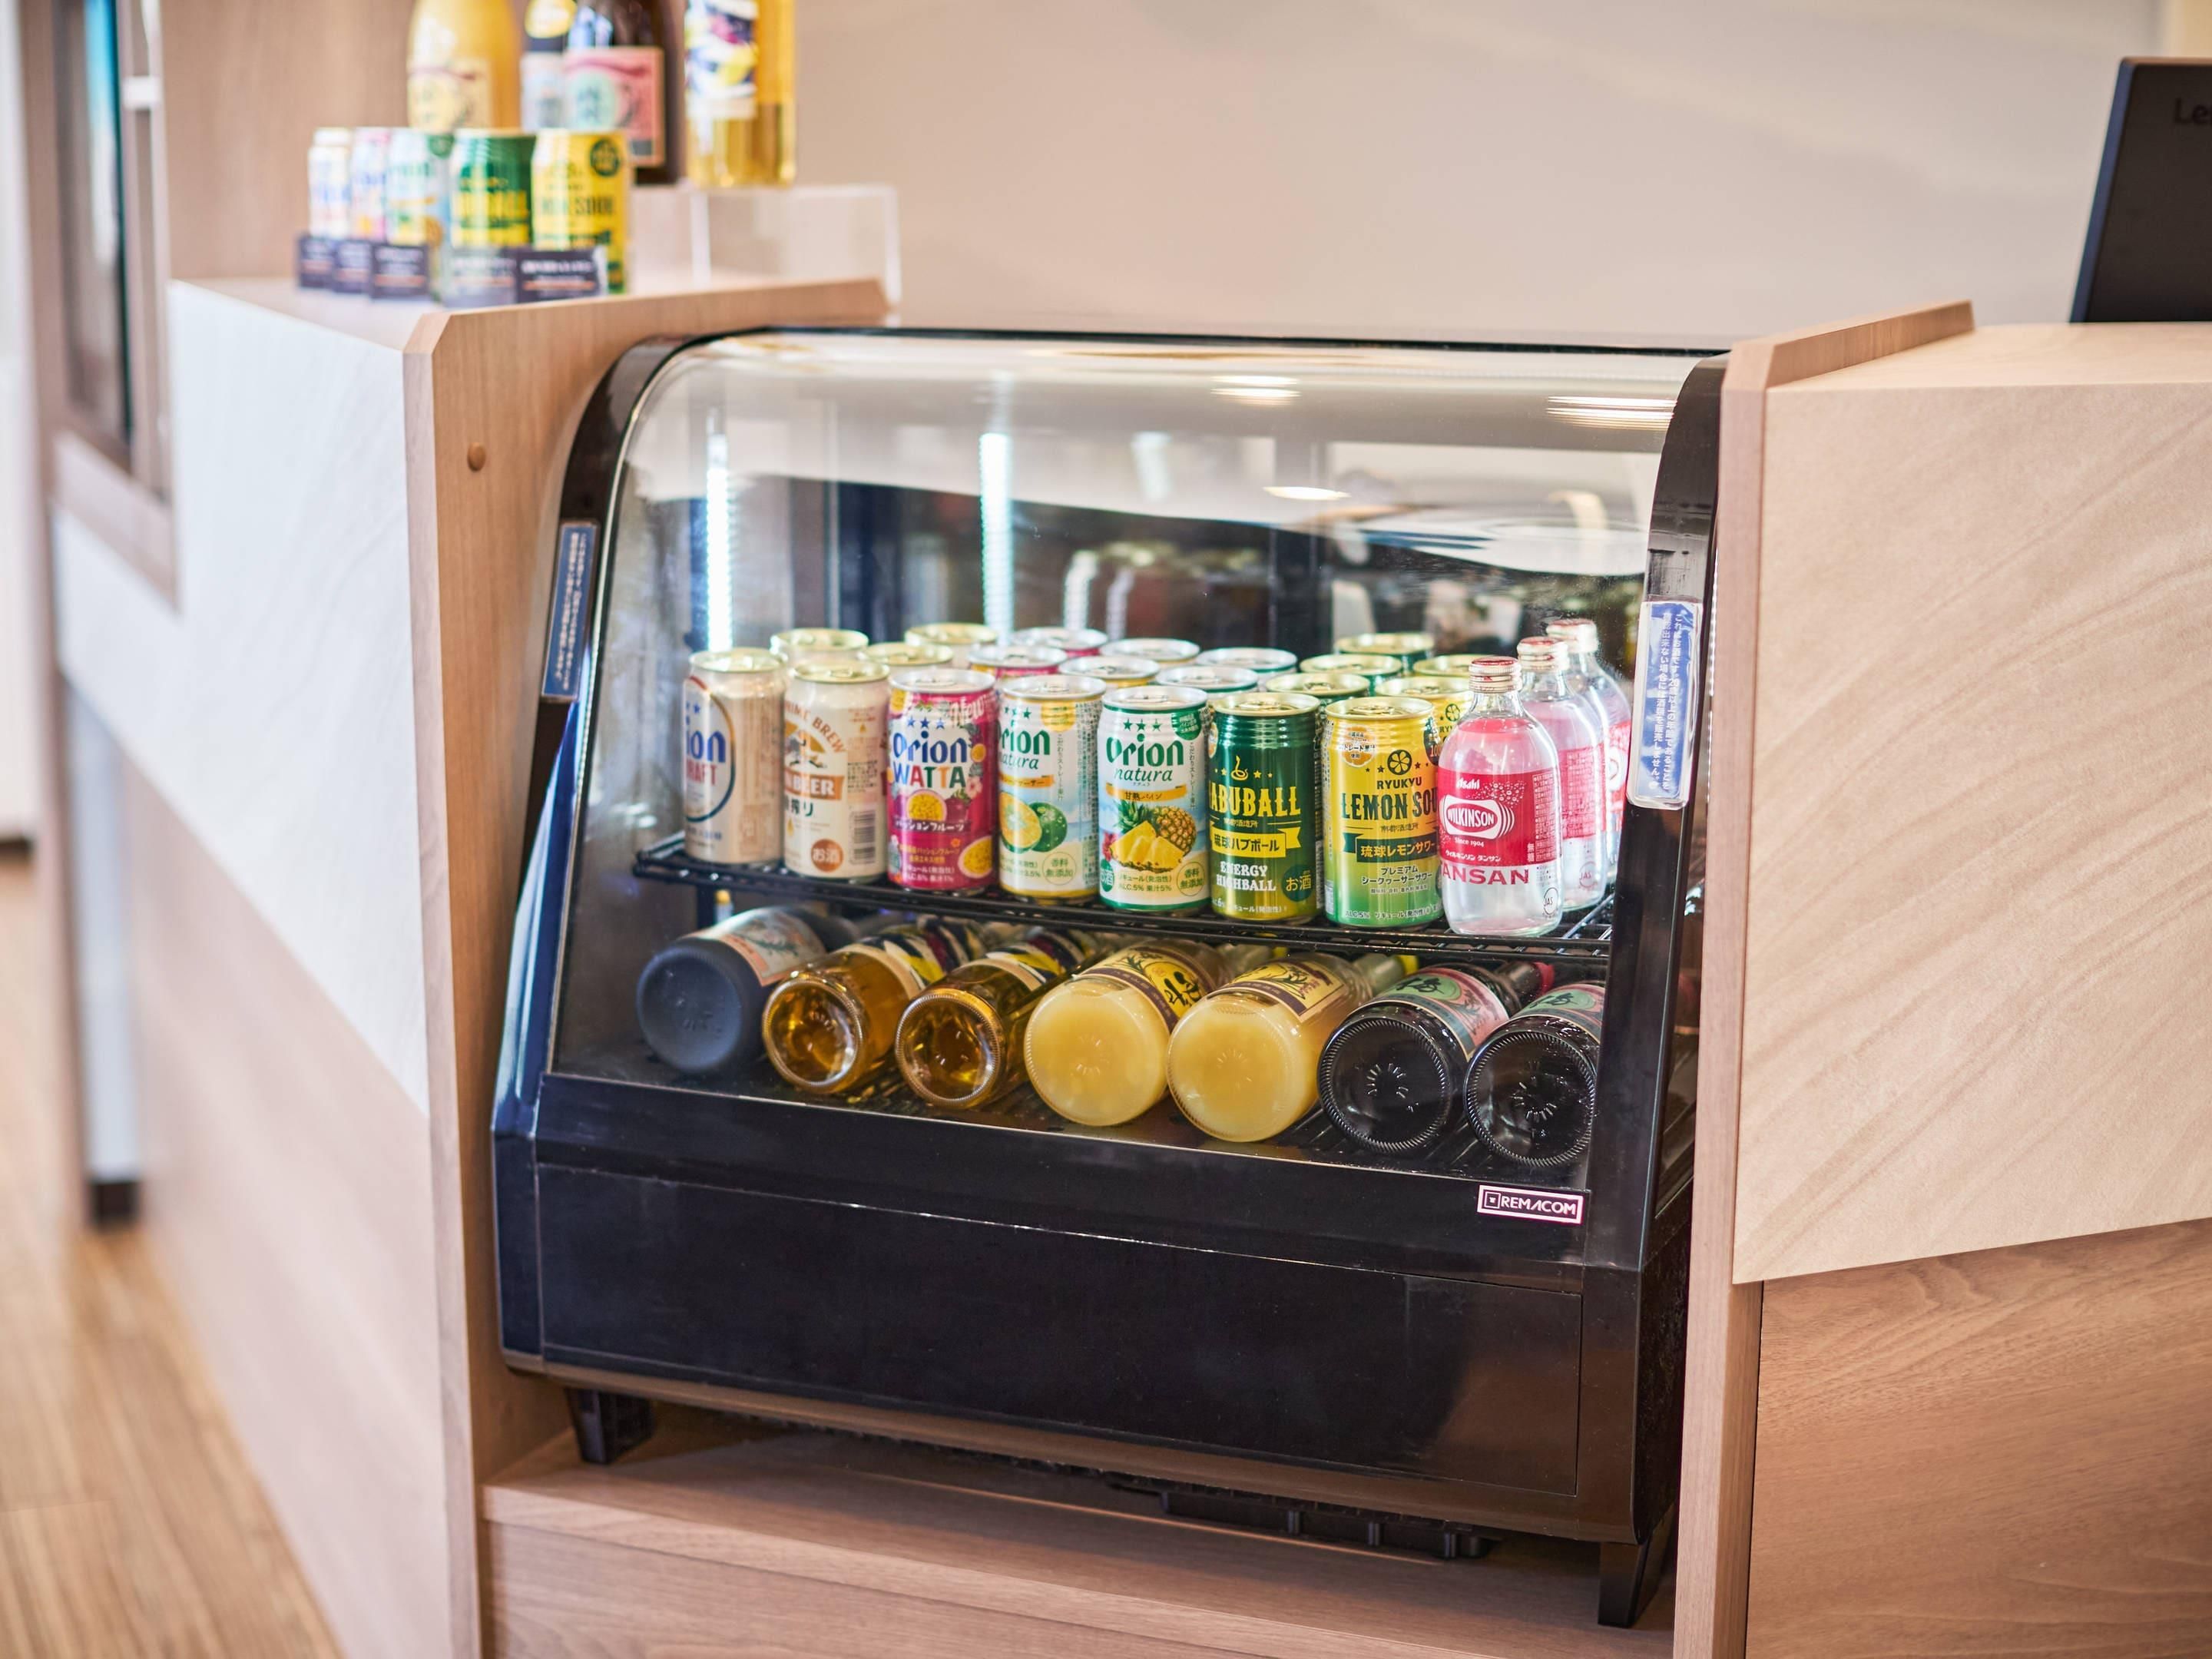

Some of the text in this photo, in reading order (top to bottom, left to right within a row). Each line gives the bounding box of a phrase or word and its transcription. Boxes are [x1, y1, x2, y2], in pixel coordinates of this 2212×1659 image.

[2175, 97, 2212, 124] Le
[686, 716, 727, 763] ion
[811, 716, 847, 753] BREW
[1001, 719, 1051, 757] rion
[892, 730, 968, 764] Orion
[1105, 733, 1184, 767] Orion
[892, 761, 967, 789] WATTA
[1114, 767, 1174, 782] natura
[1376, 776, 1422, 790] RYUKYU
[1455, 777, 1481, 790] Asahi
[1341, 786, 1439, 821] LEMON SOU
[1447, 807, 1495, 828] WILKINSON
[1360, 840, 1436, 859] 琉球レモンサワー
[1454, 836, 1485, 848] Since 1904
[1220, 860, 1268, 877] ENERGY
[1380, 865, 1419, 876] プレミアム
[1442, 862, 1529, 886] ANSAN
[1216, 874, 1277, 892] HIGHBALL
[1285, 874, 1312, 892] お酒
[1500, 1195, 1577, 1216] REMACOM
